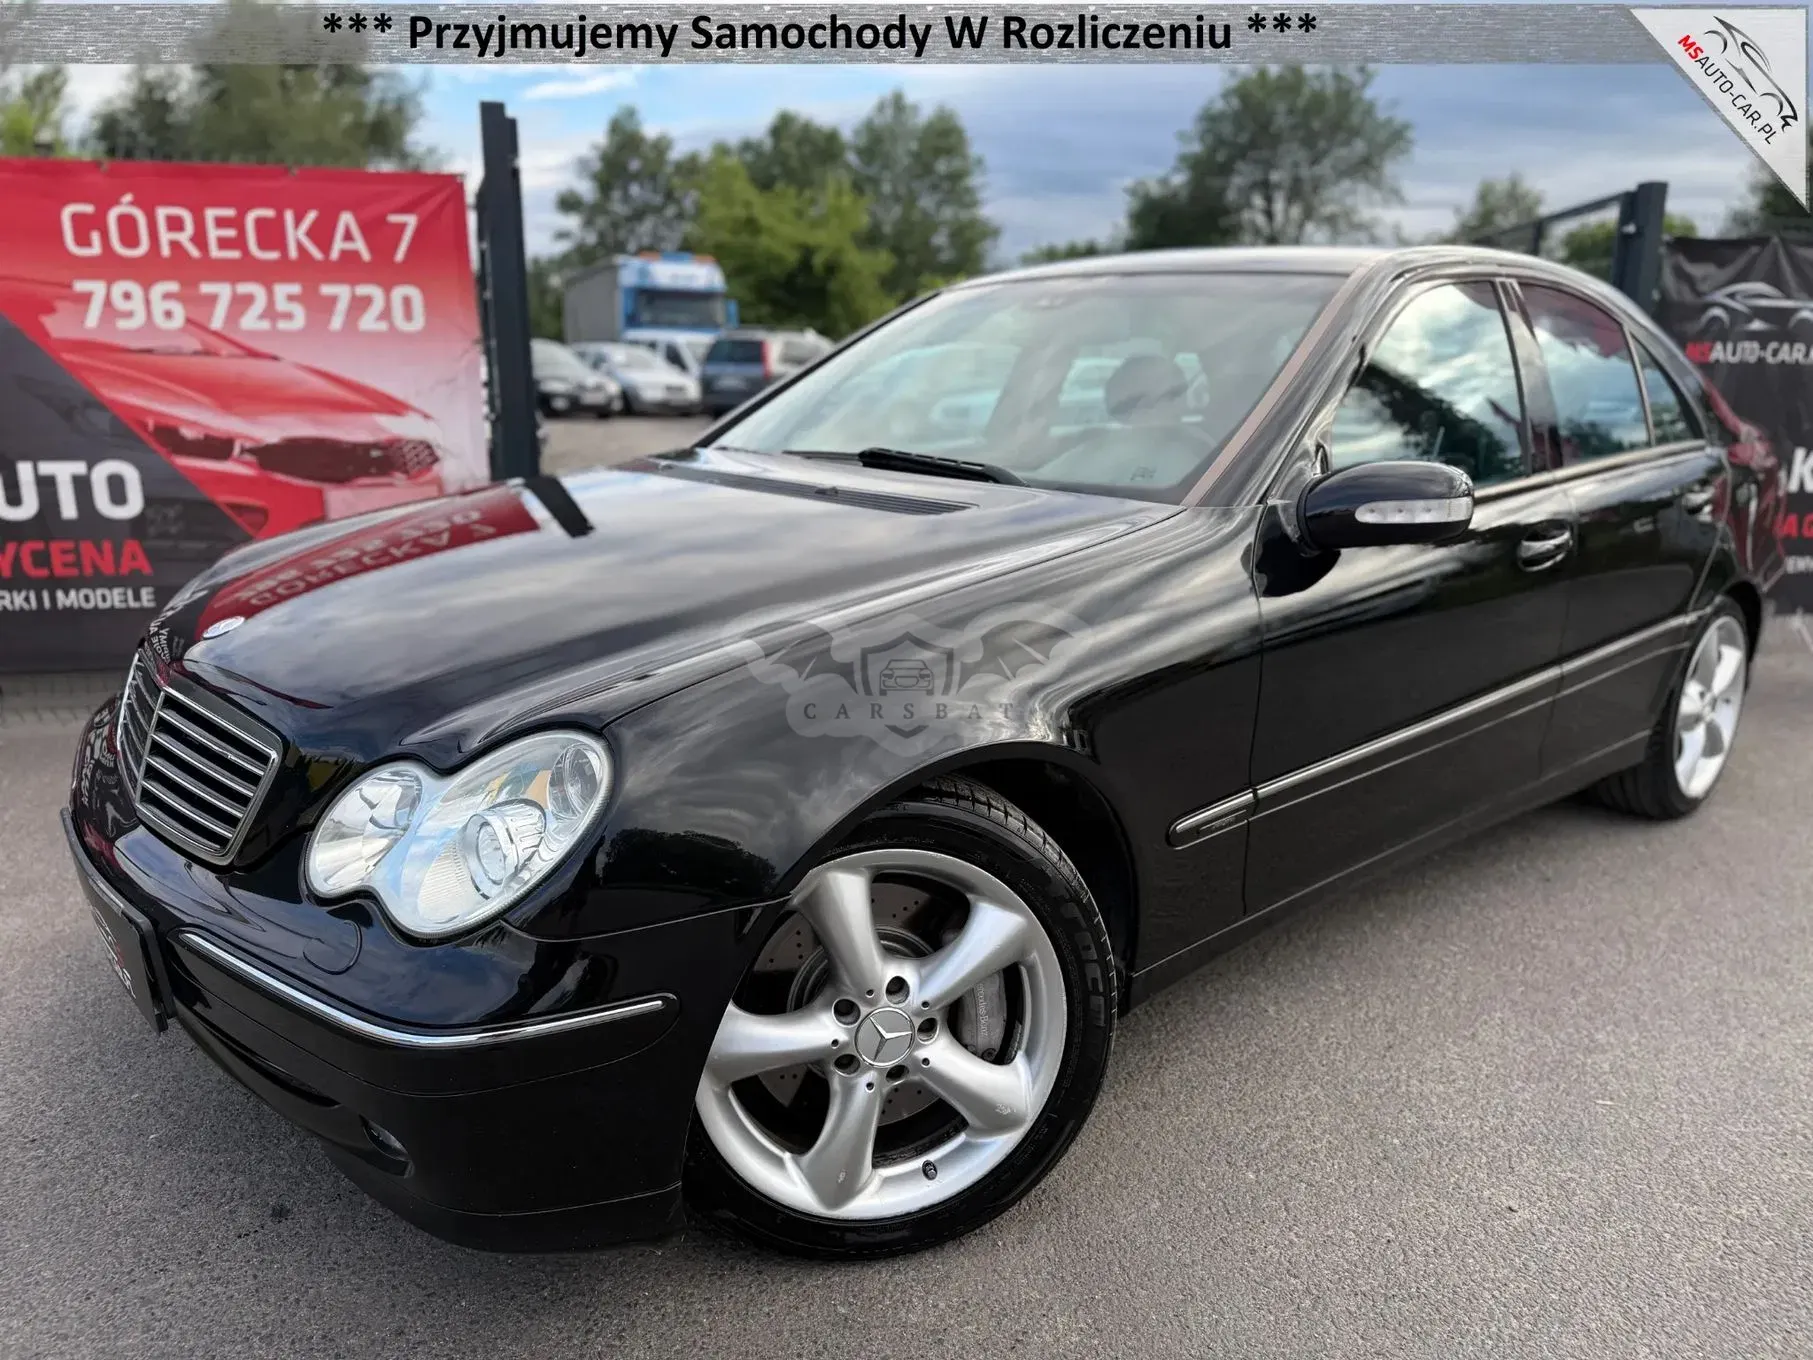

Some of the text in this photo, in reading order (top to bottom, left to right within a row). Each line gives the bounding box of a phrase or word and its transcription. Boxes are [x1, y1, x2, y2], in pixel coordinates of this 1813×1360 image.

[60, 192, 418, 263] GÓRECKA 7
[73, 280, 426, 333] 796 725 720
[55, 586, 157, 611] MODELE
